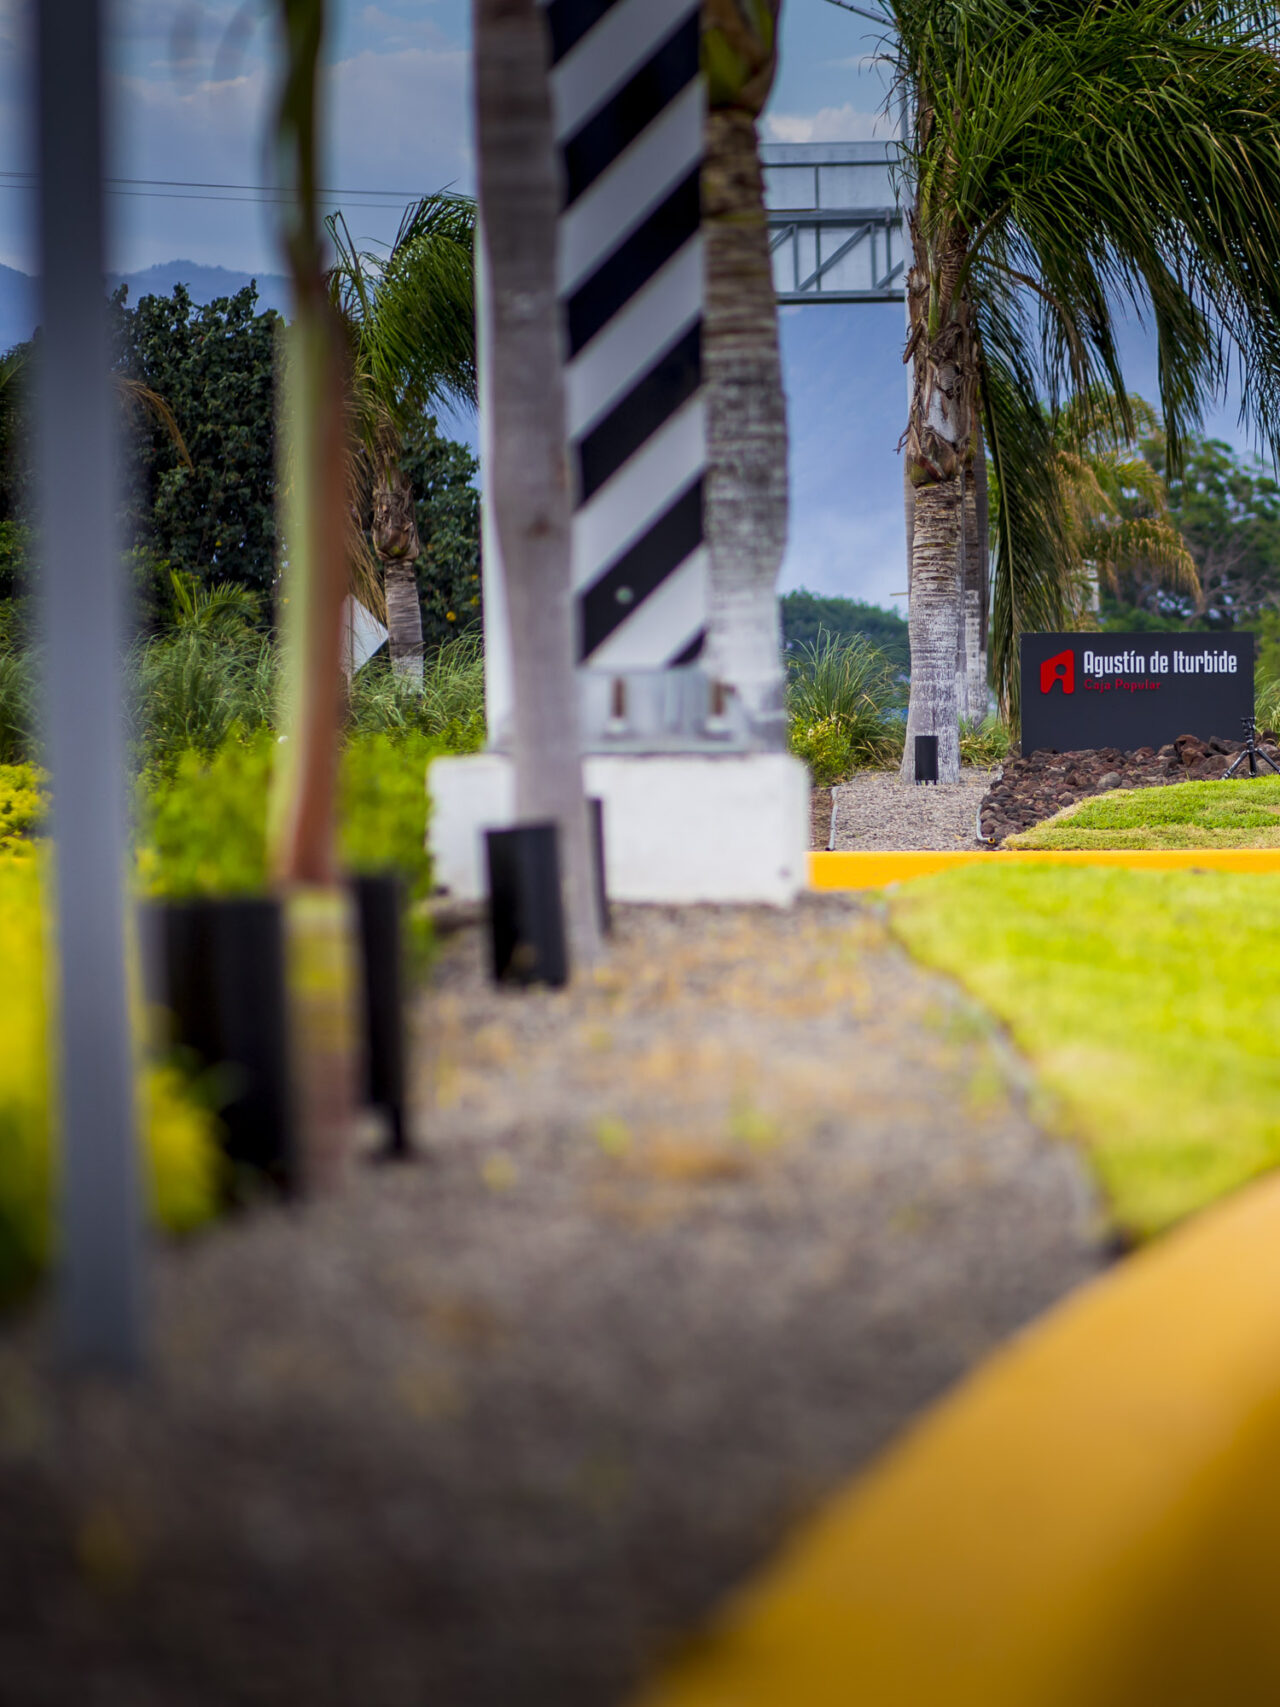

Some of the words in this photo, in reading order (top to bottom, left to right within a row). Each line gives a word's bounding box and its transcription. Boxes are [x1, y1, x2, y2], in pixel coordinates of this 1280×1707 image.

[1083, 650, 1145, 678] Agustín
[1150, 650, 1168, 674] de
[1173, 650, 1237, 674] Iturbide
[1084, 679, 1111, 693] Caja
[1115, 679, 1161, 693] Popular
